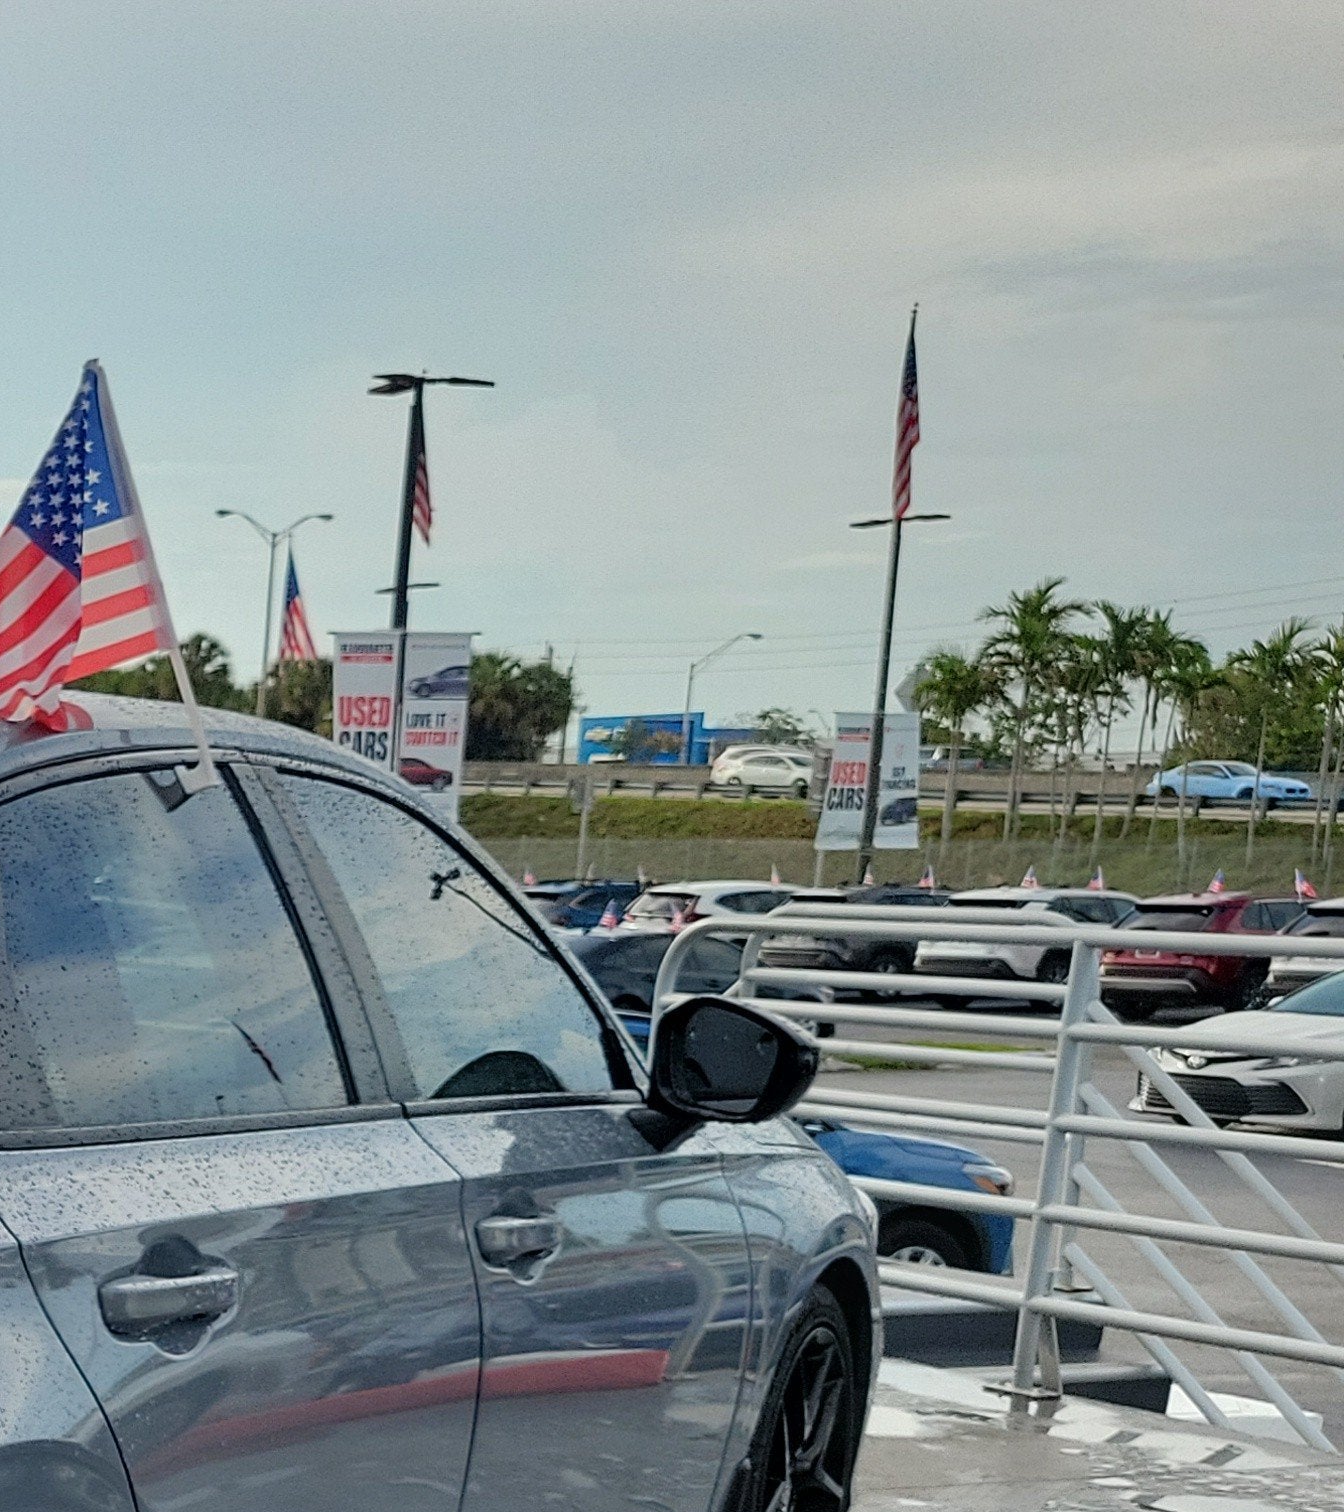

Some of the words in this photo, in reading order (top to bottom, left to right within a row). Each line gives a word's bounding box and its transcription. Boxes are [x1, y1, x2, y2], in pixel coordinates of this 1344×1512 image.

[339, 696, 391, 727] USED
[339, 731, 388, 761] CARS
[832, 762, 866, 785] USED
[827, 787, 865, 811] CARS
